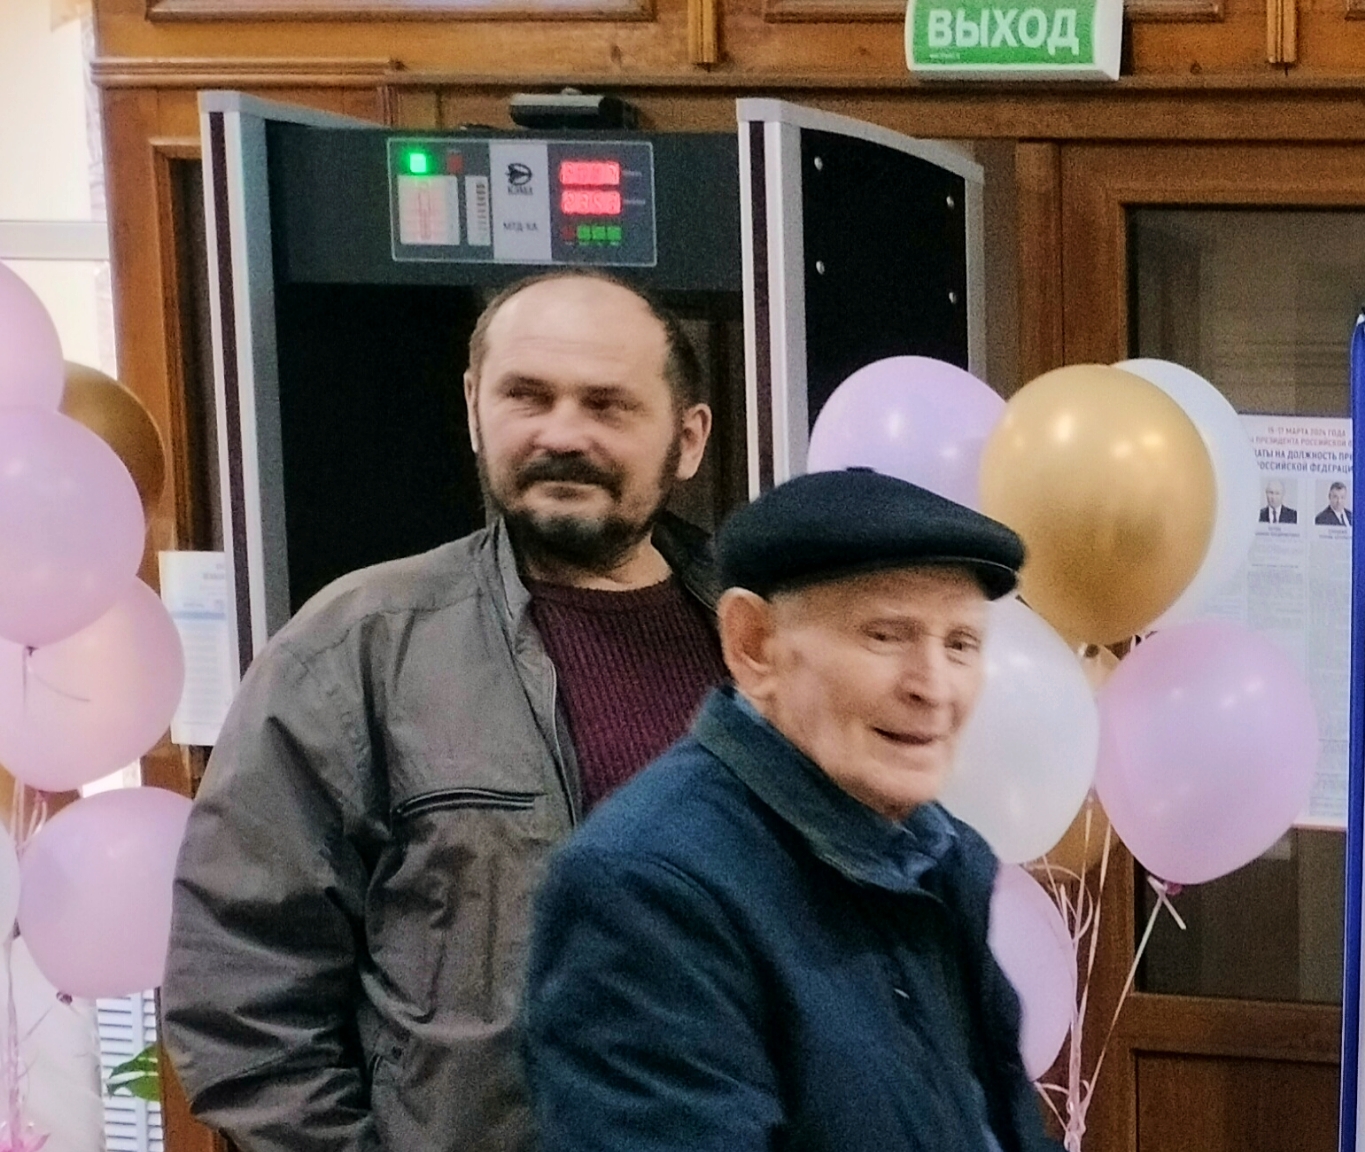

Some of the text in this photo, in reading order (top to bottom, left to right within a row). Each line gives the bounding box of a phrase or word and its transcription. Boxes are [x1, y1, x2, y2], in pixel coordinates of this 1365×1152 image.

[928, 8, 1080, 56] ВЫХОД
[1287, 451, 1337, 461] ДОЛЖНОСТЬ
[1258, 461, 1308, 472] ОССИЙСКОЙ
